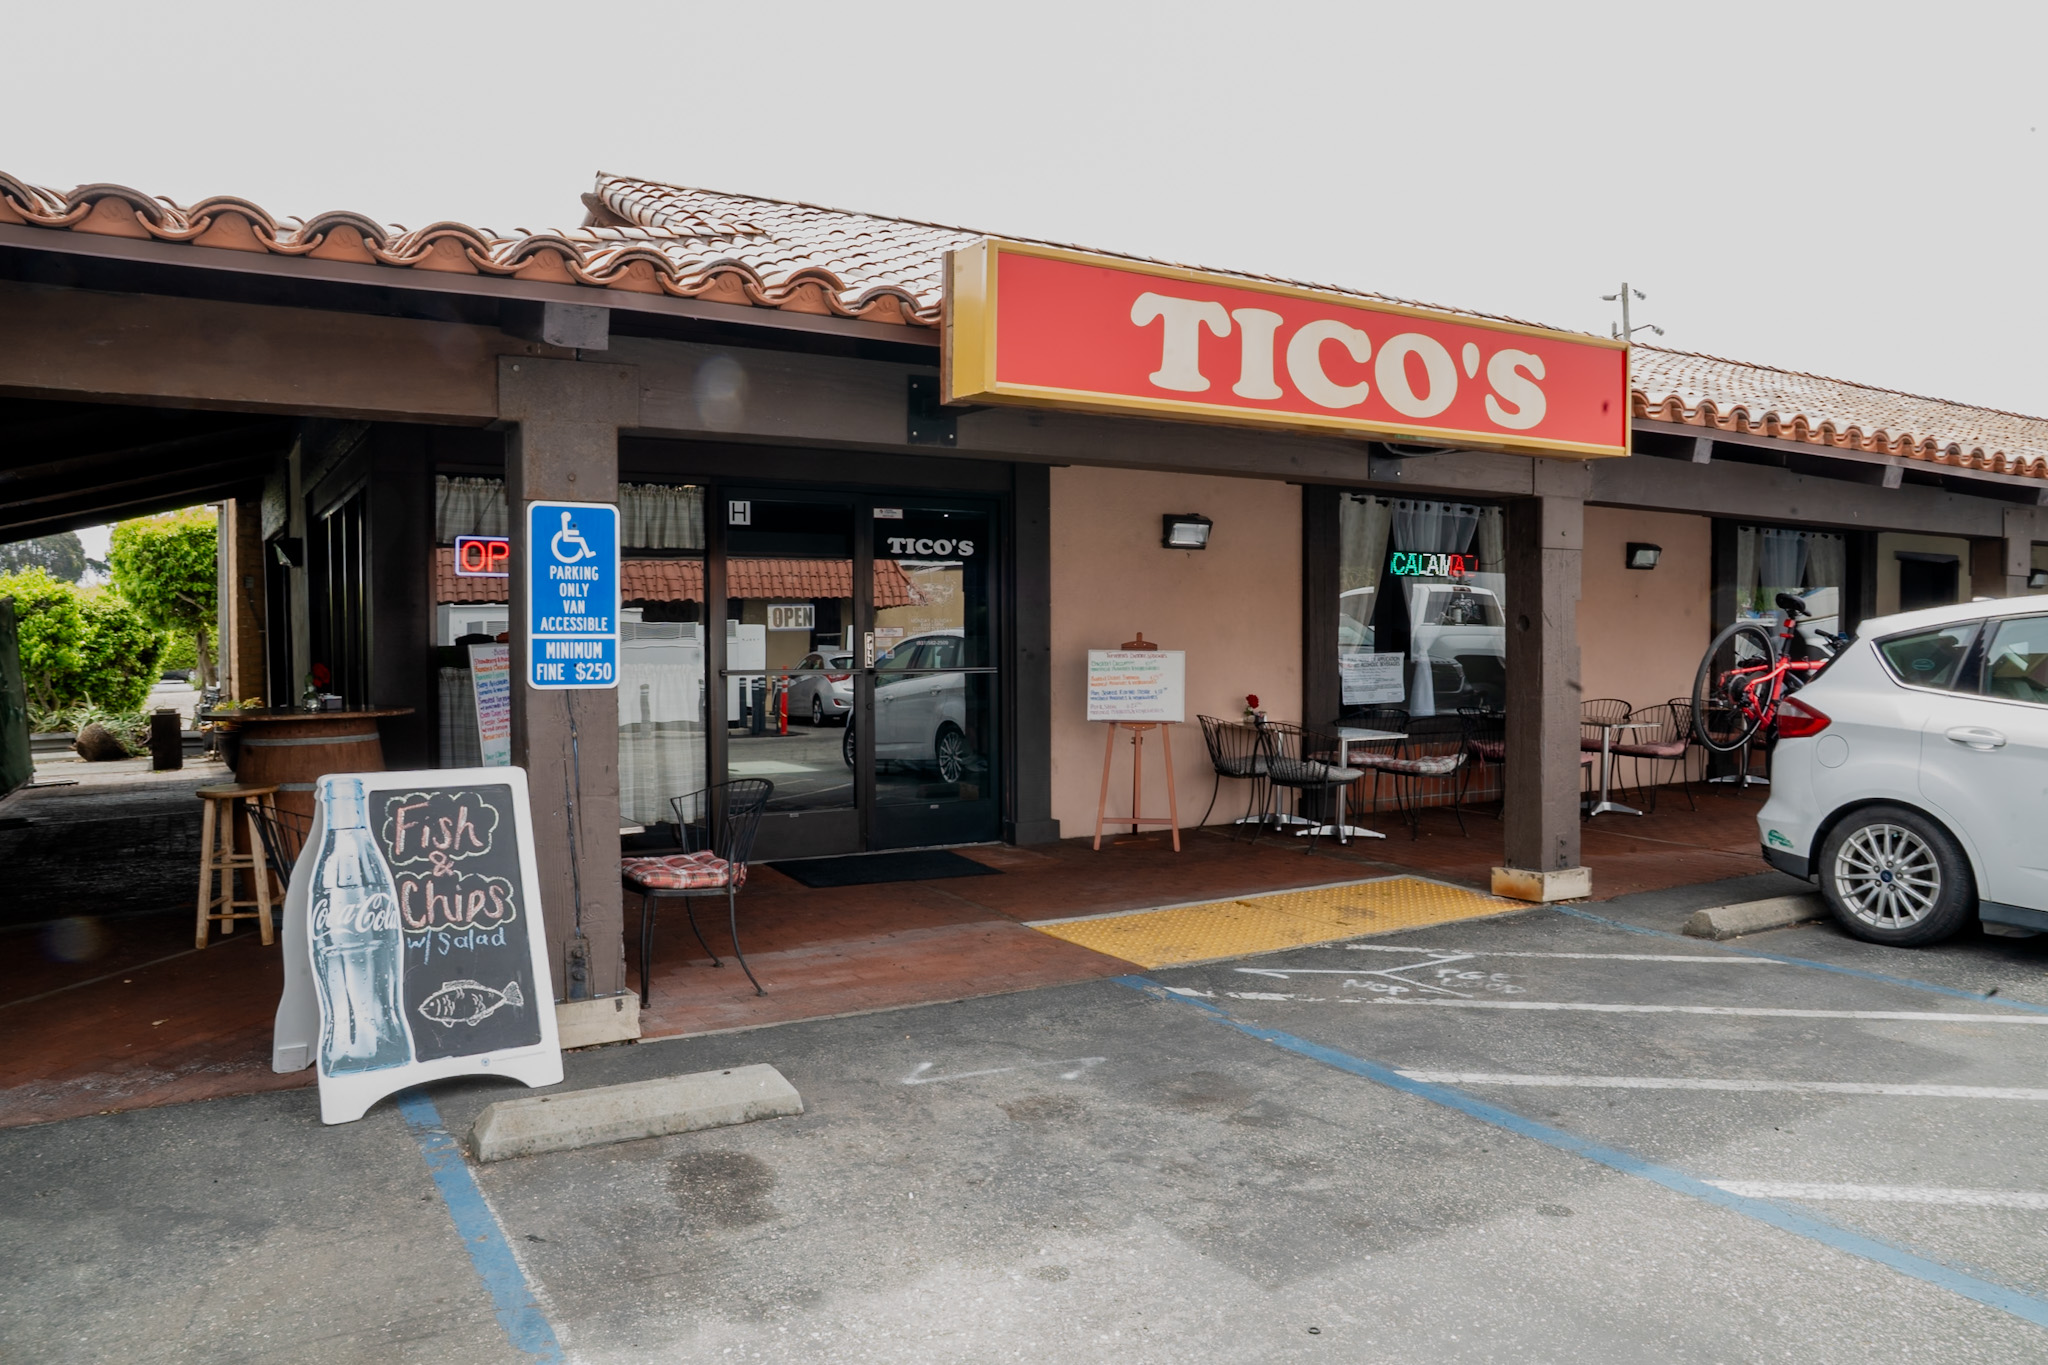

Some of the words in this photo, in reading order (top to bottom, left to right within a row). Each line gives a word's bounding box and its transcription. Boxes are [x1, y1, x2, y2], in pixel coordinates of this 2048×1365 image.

[1130, 292, 1546, 430] TICO'S
[732, 503, 746, 522] H
[887, 537, 974, 556] TICO'S
[549, 565, 599, 581] PARKING
[559, 583, 589, 597] ONLY
[563, 600, 585, 614] VAN
[540, 617, 608, 631] ACCESSIBLE
[772, 607, 813, 627] OPEN
[546, 642, 602, 659] MINIMUM
[537, 663, 565, 681] FINE
[575, 662, 612, 682] $250
[395, 802, 484, 855] Fish
[429, 850, 455, 877] &
[401, 880, 504, 929] Chips
[438, 926, 507, 956] Salad
